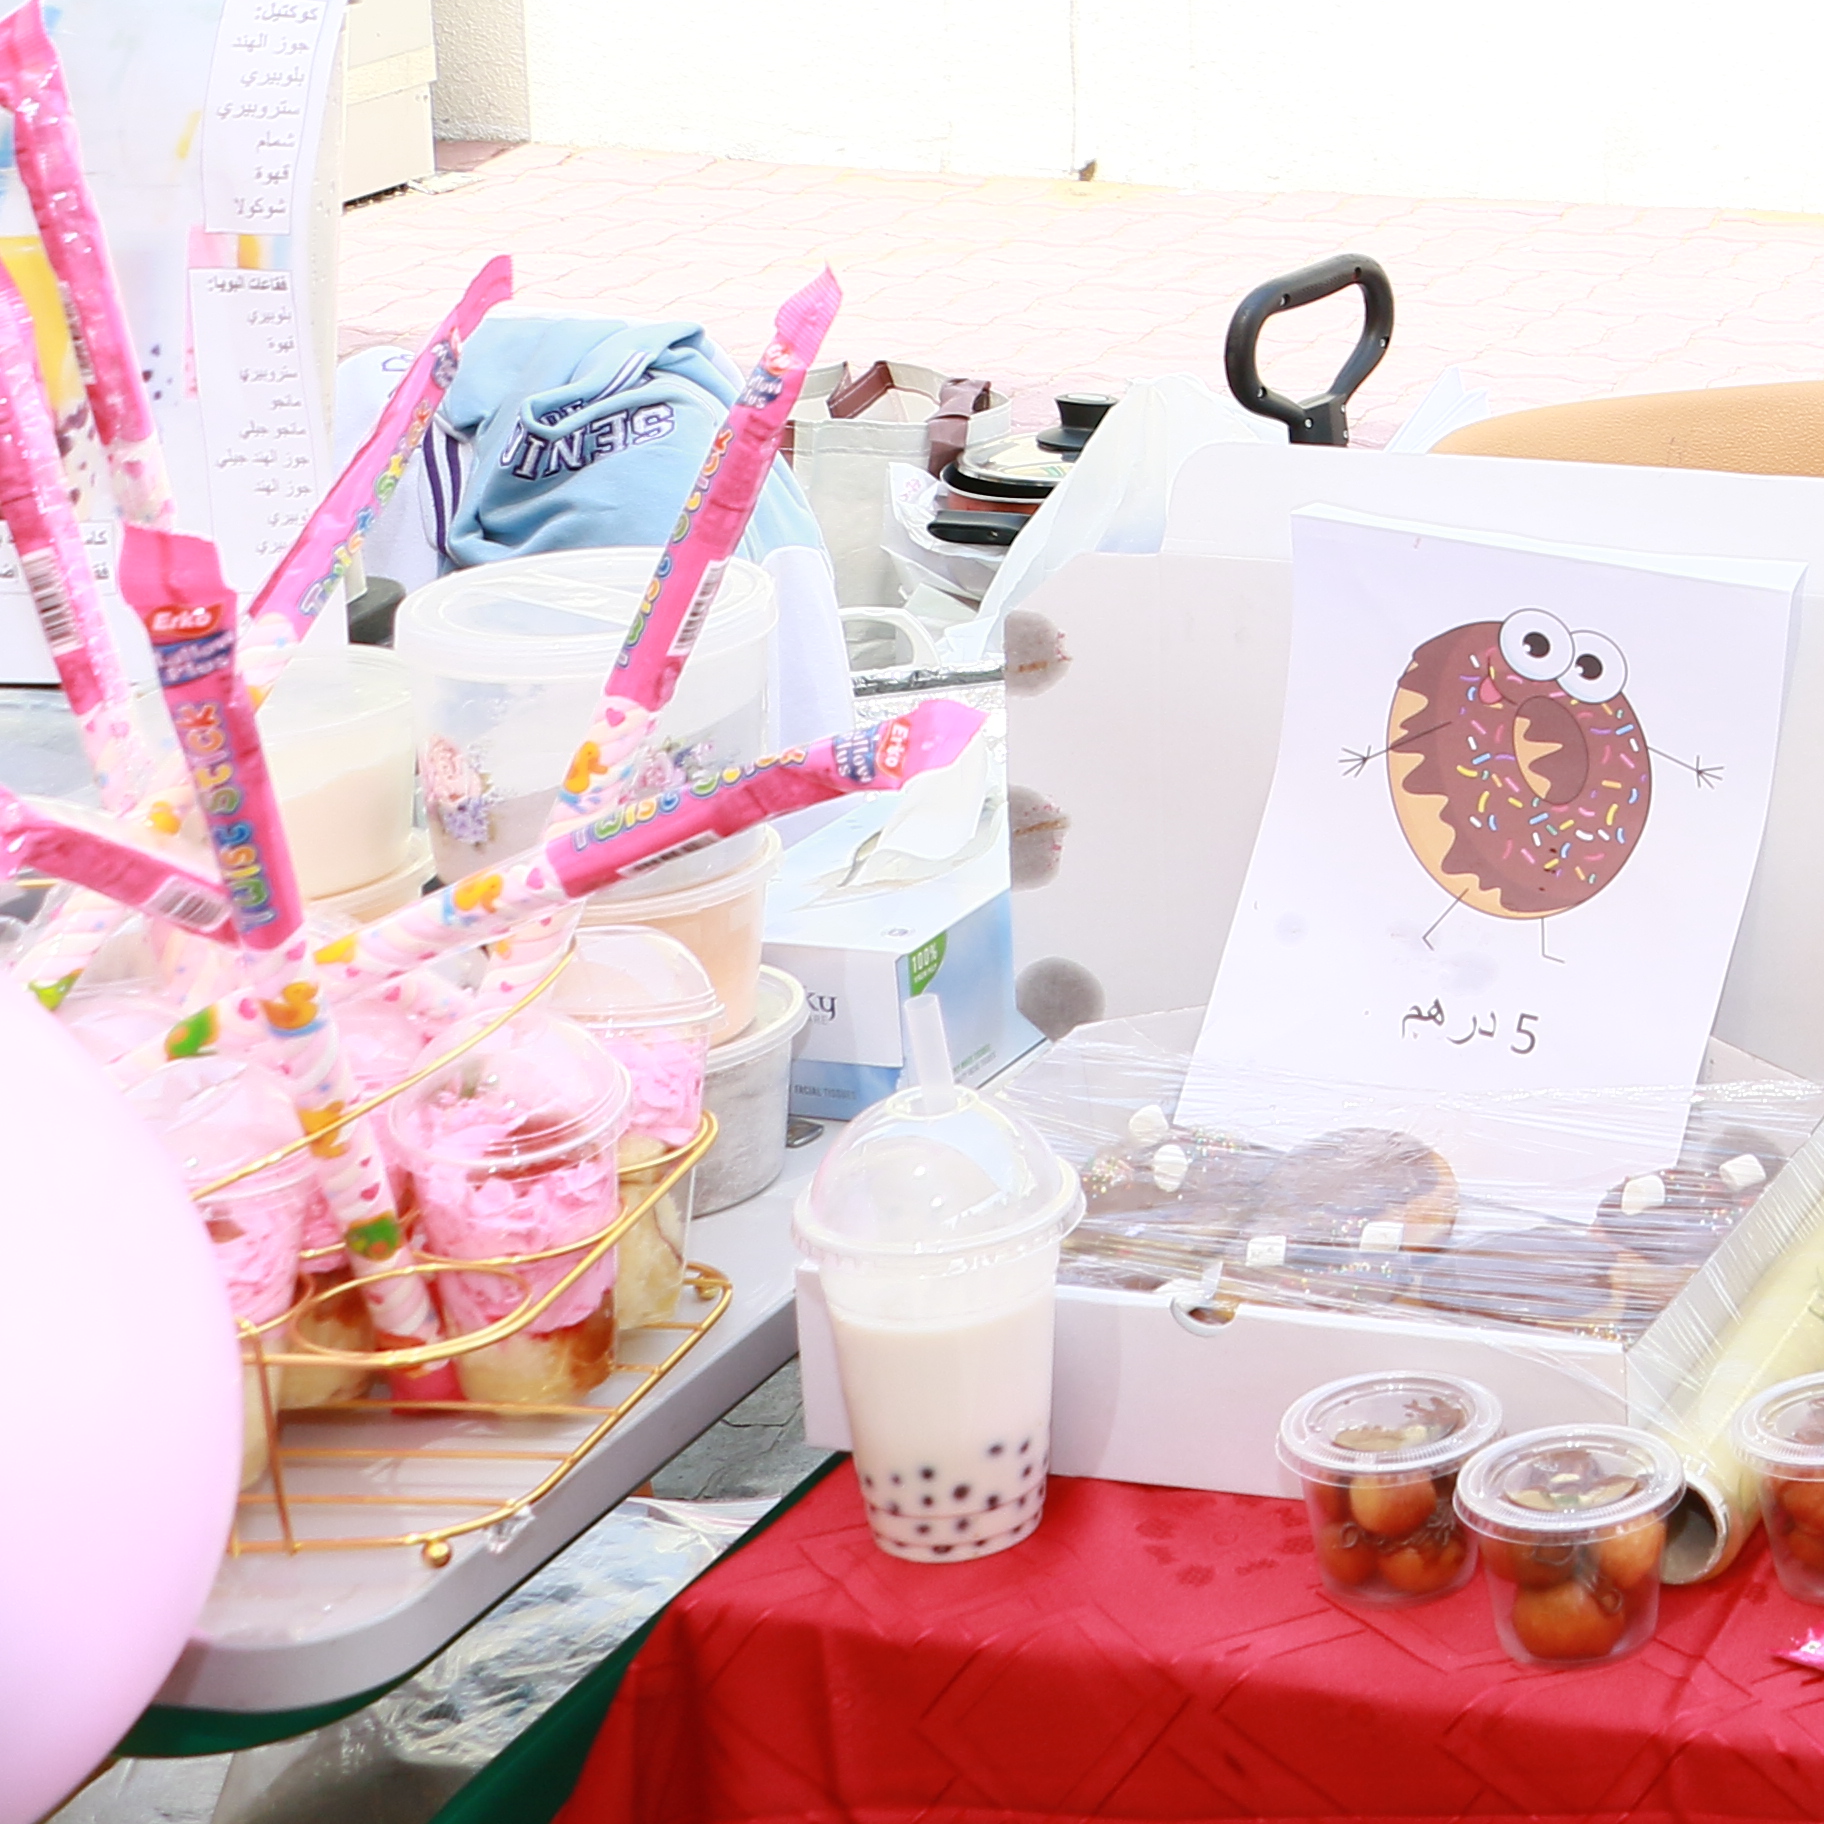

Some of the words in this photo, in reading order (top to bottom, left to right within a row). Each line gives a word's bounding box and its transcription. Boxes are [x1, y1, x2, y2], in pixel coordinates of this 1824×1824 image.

[273, 36, 310, 55] جوز
[255, 164, 290, 185] قهوة
[1511, 1011, 1541, 1057] 5
